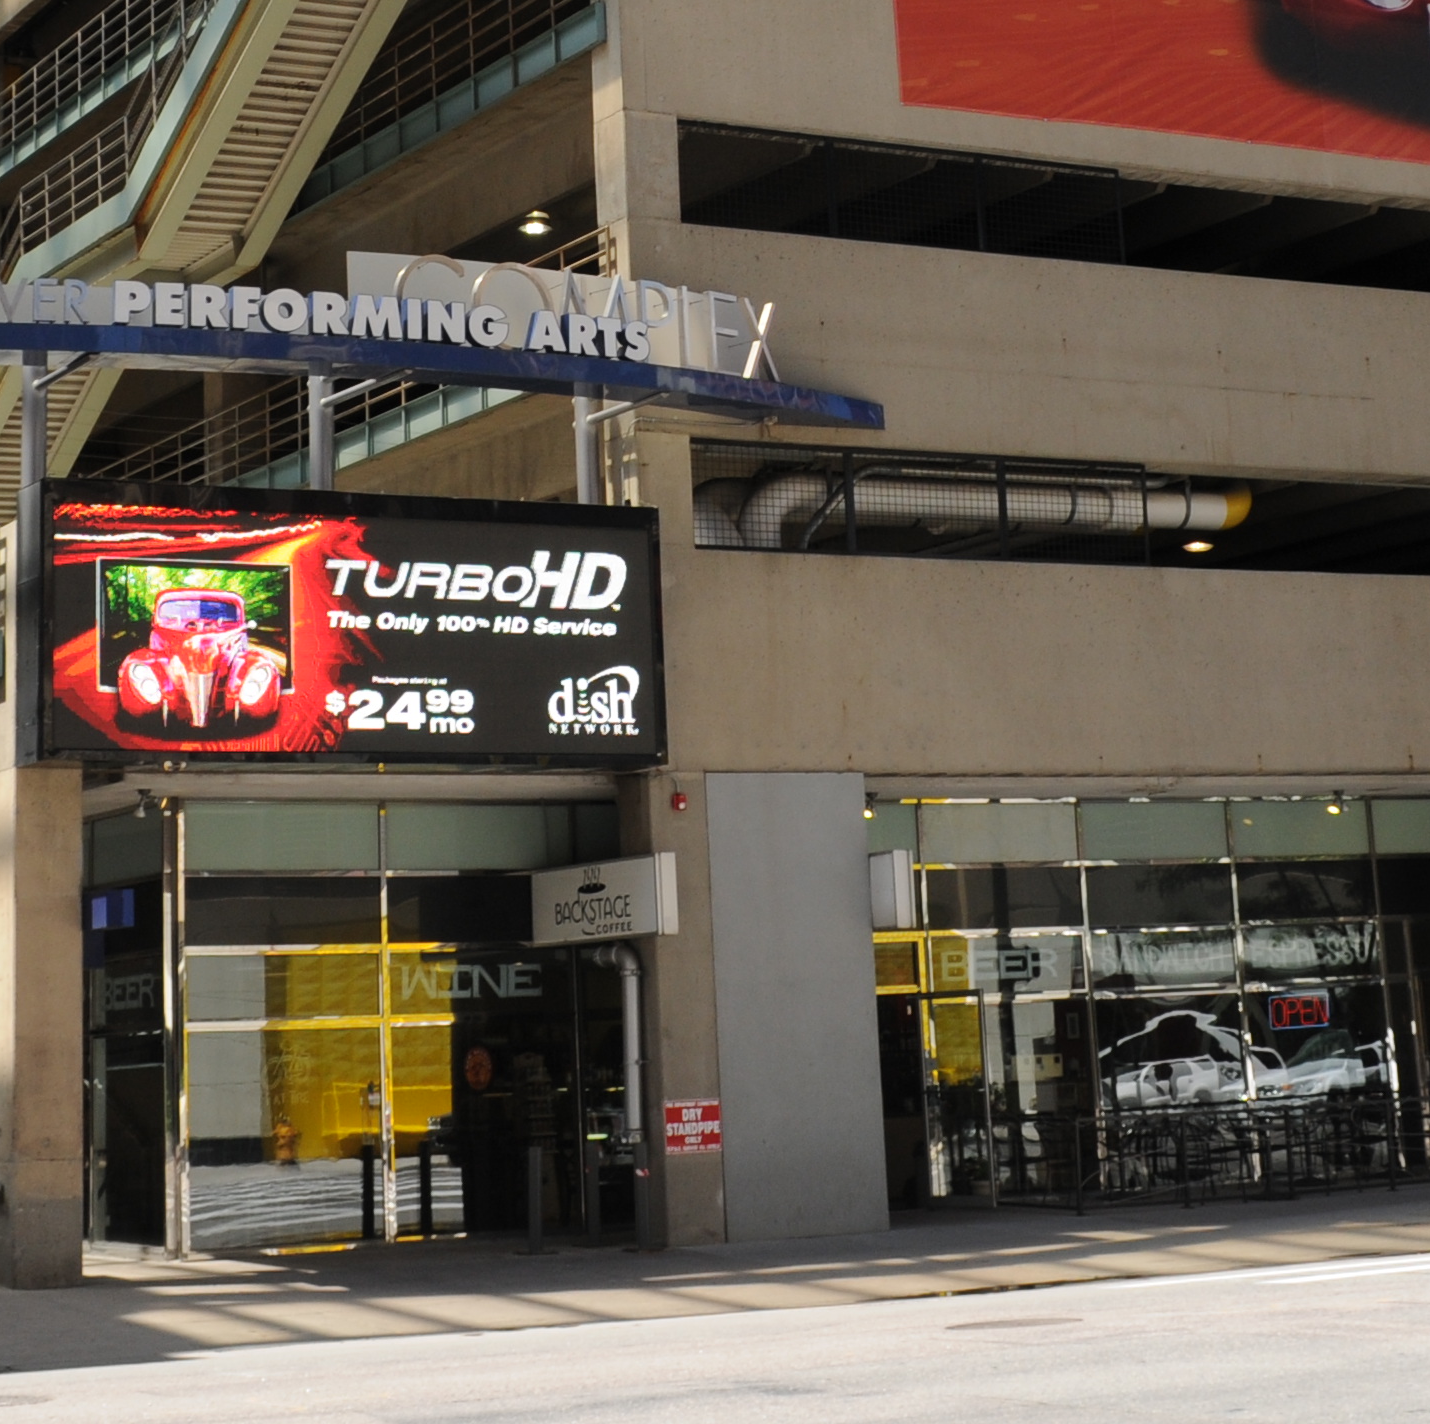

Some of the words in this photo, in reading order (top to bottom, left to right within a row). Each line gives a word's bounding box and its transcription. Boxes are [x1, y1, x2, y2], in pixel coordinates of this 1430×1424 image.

[112, 279, 511, 349] PERFORMING
[522, 309, 652, 362] ARTS
[324, 549, 628, 611] TURBOHD
[327, 610, 371, 631] The
[376, 611, 429, 635] Only
[492, 616, 529, 636] HD
[533, 616, 618, 637] Service
[547, 671, 638, 724] dish
[429, 715, 476, 734] mo
[548, 722, 639, 736] NETWORK
[554, 894, 632, 926] BACKSTAGE
[596, 921, 633, 935] COFFEE
[942, 947, 1058, 982] BEER
[1101, 938, 1233, 975] SANDWICH
[104, 976, 157, 1011] BEER
[400, 962, 545, 1001] WINE
[1272, 995, 1330, 1028] OPEN
[666, 1120, 721, 1136] STANDPIPE
[682, 1107, 703, 1122] DRY
